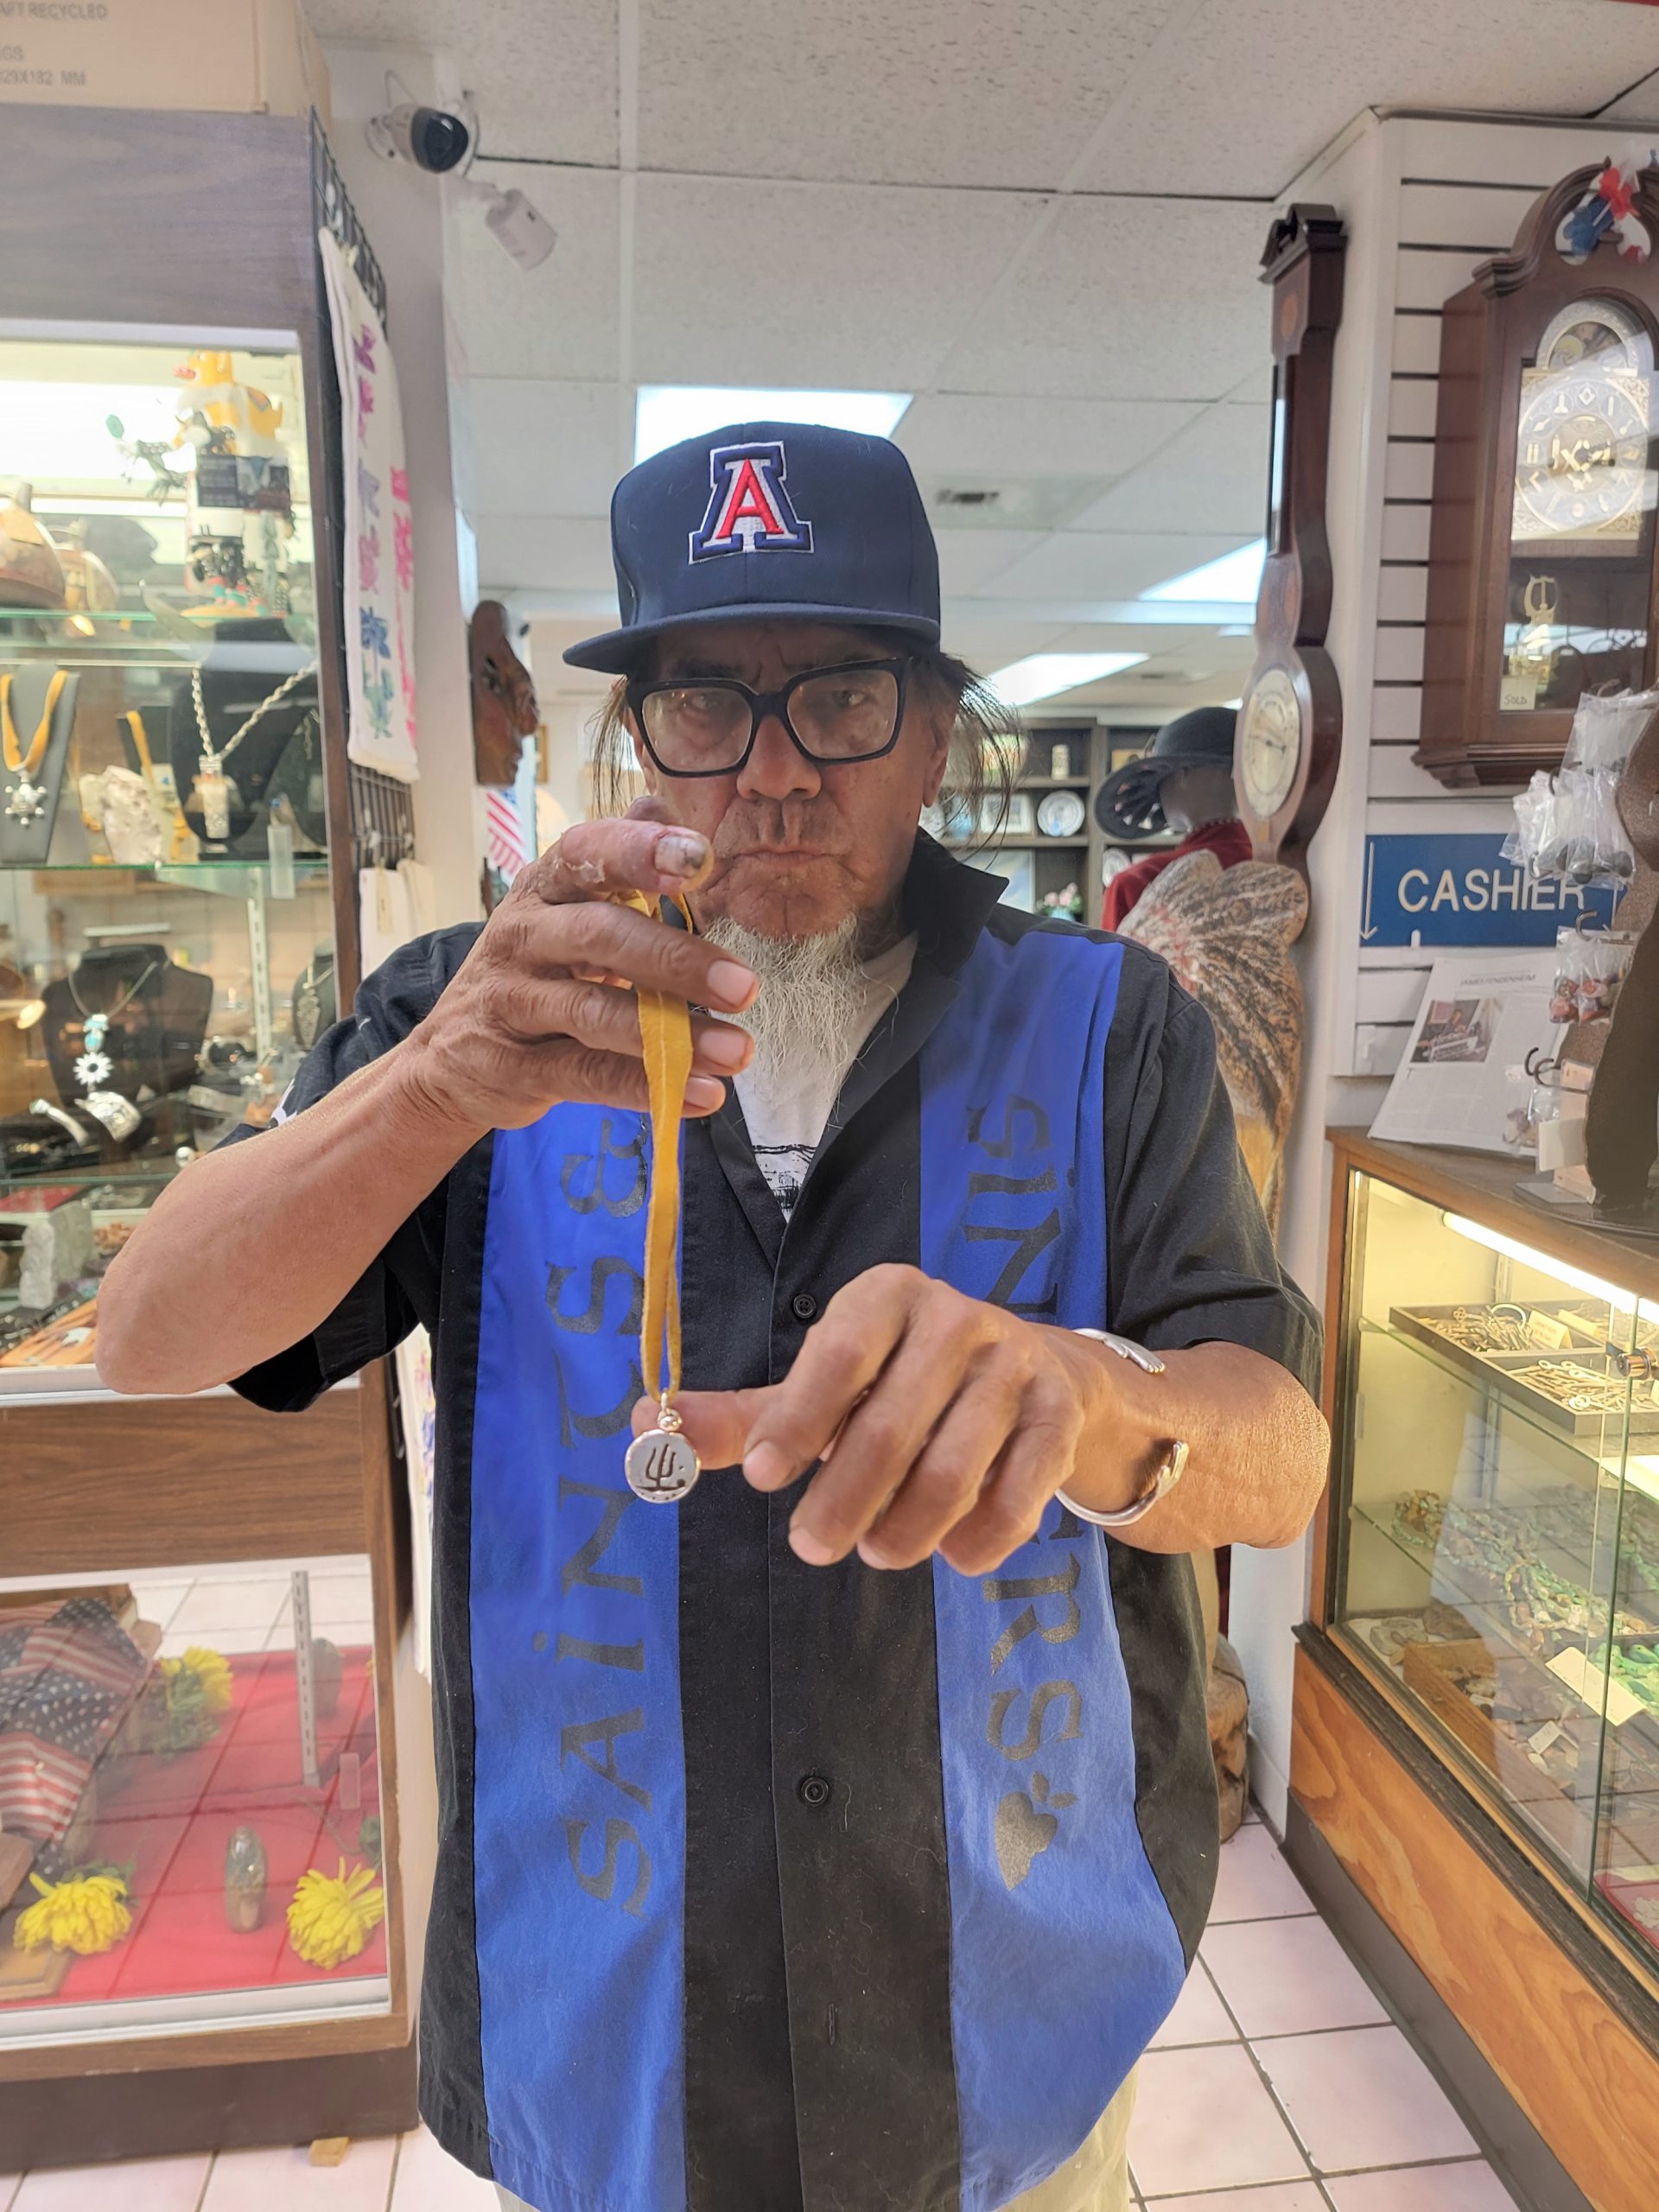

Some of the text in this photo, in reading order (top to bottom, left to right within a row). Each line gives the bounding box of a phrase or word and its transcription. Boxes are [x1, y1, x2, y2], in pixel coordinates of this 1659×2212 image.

[28, 3, 109, 20] RECYCLED
[60, 70, 86, 86] MM
[689, 442, 814, 565] A
[1504, 694, 1528, 705] SOLD
[1398, 868, 1585, 912] CASHIER
[559, 1118, 650, 1217] &
